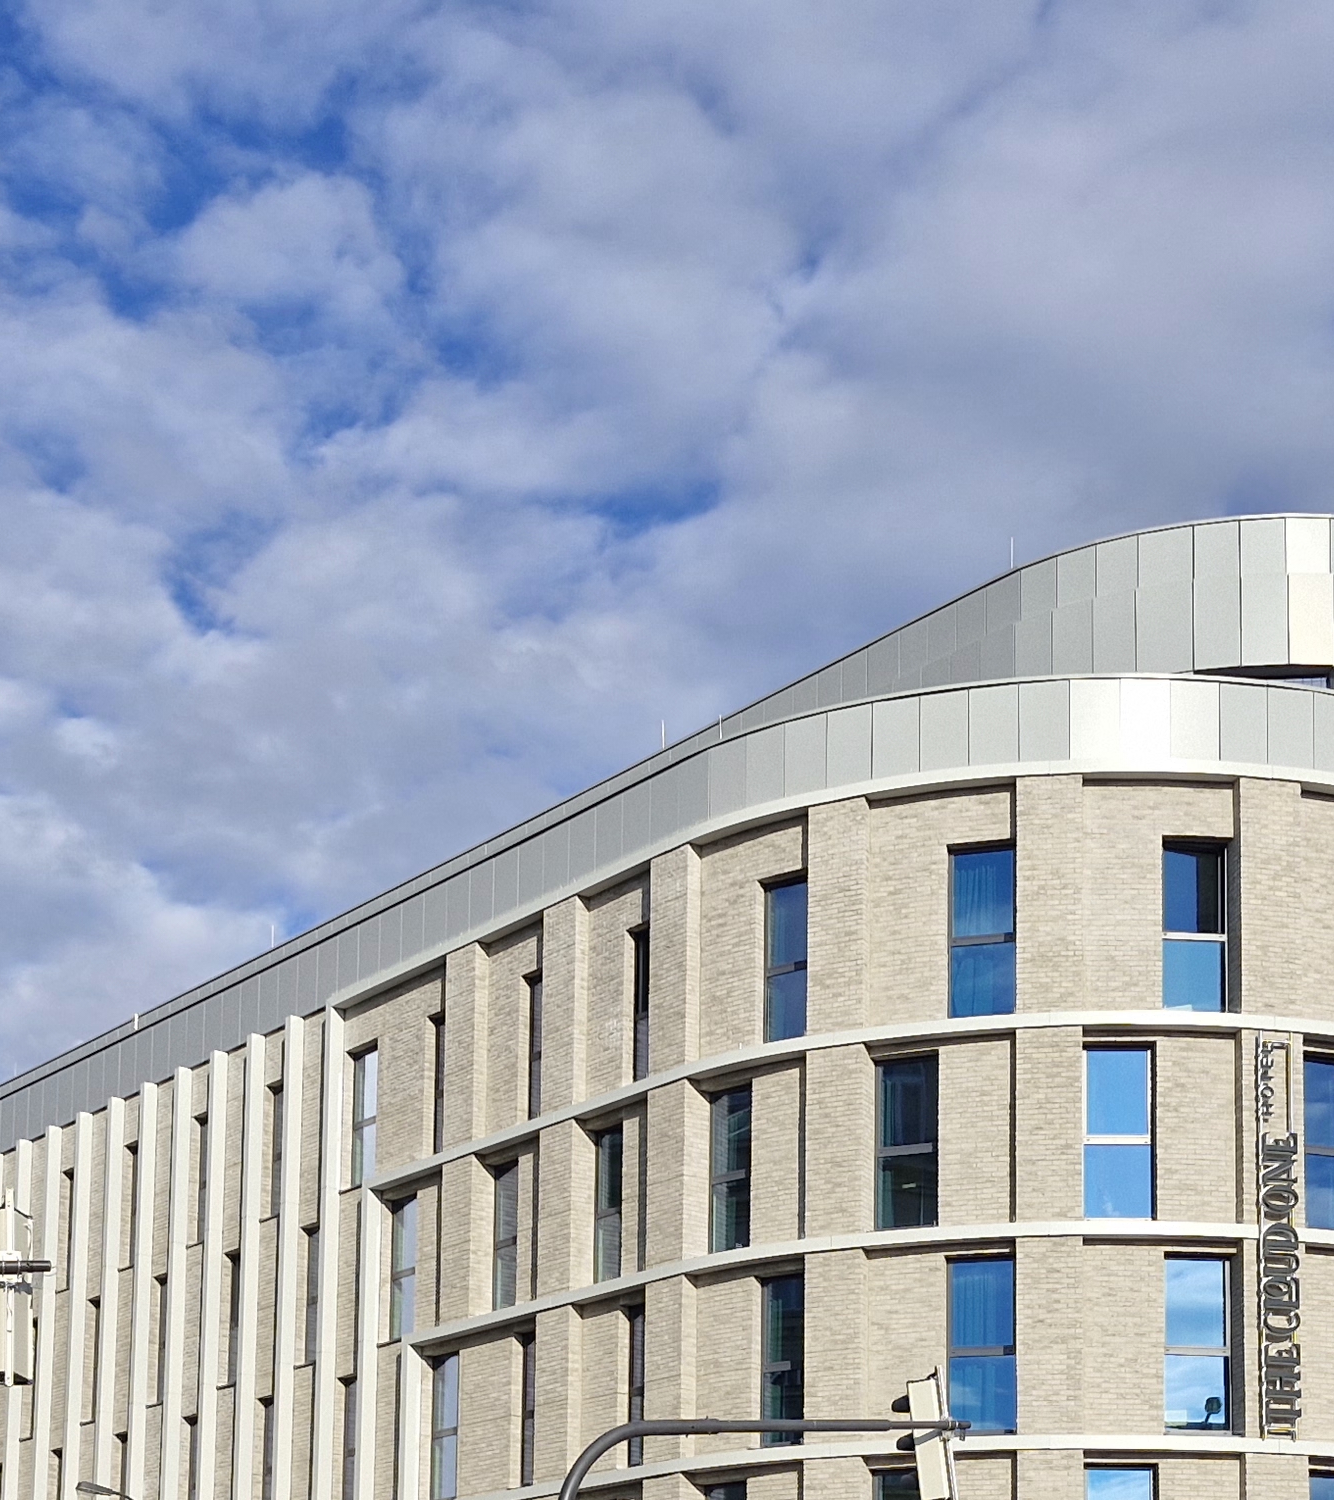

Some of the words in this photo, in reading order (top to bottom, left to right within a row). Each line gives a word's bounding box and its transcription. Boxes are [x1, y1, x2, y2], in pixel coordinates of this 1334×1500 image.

[1261, 1132, 1299, 1216] ONE
[1262, 1223, 1301, 1338] CLOUD
[1264, 1343, 1302, 1427] THE
